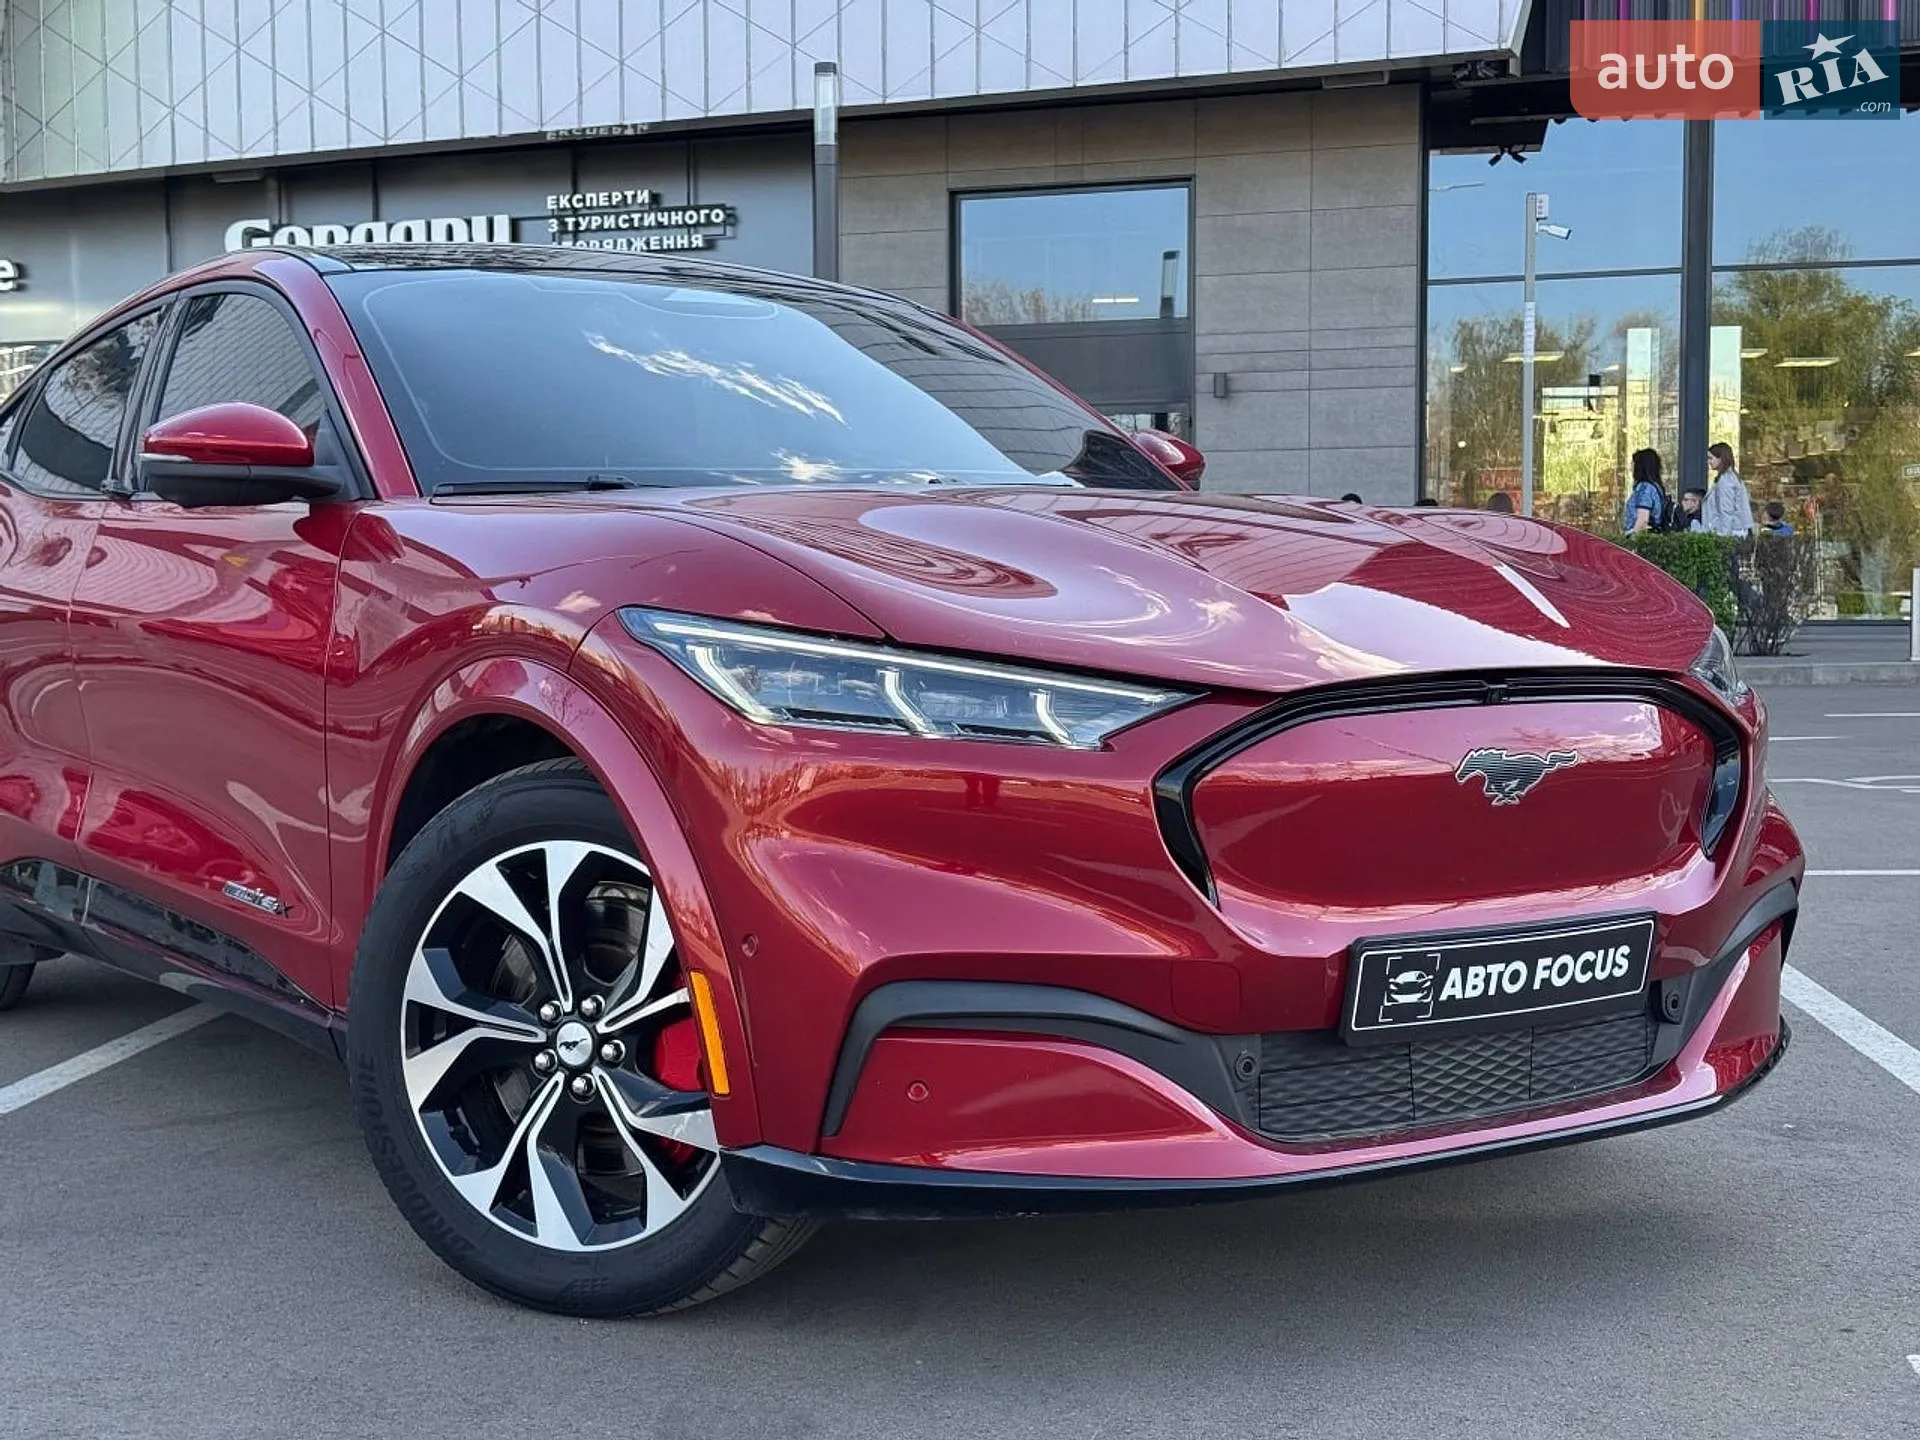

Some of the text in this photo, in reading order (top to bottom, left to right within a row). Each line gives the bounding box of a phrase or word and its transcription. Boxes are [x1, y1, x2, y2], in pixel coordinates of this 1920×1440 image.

[546, 189, 650, 209] ЕКСПЕРТИ
[565, 208, 725, 231] ТУРИСТИЧНОГО
[552, 233, 704, 252] ОРЯДЖЕННЯ
[1439, 944, 1631, 1001] АВТО FOCUS
